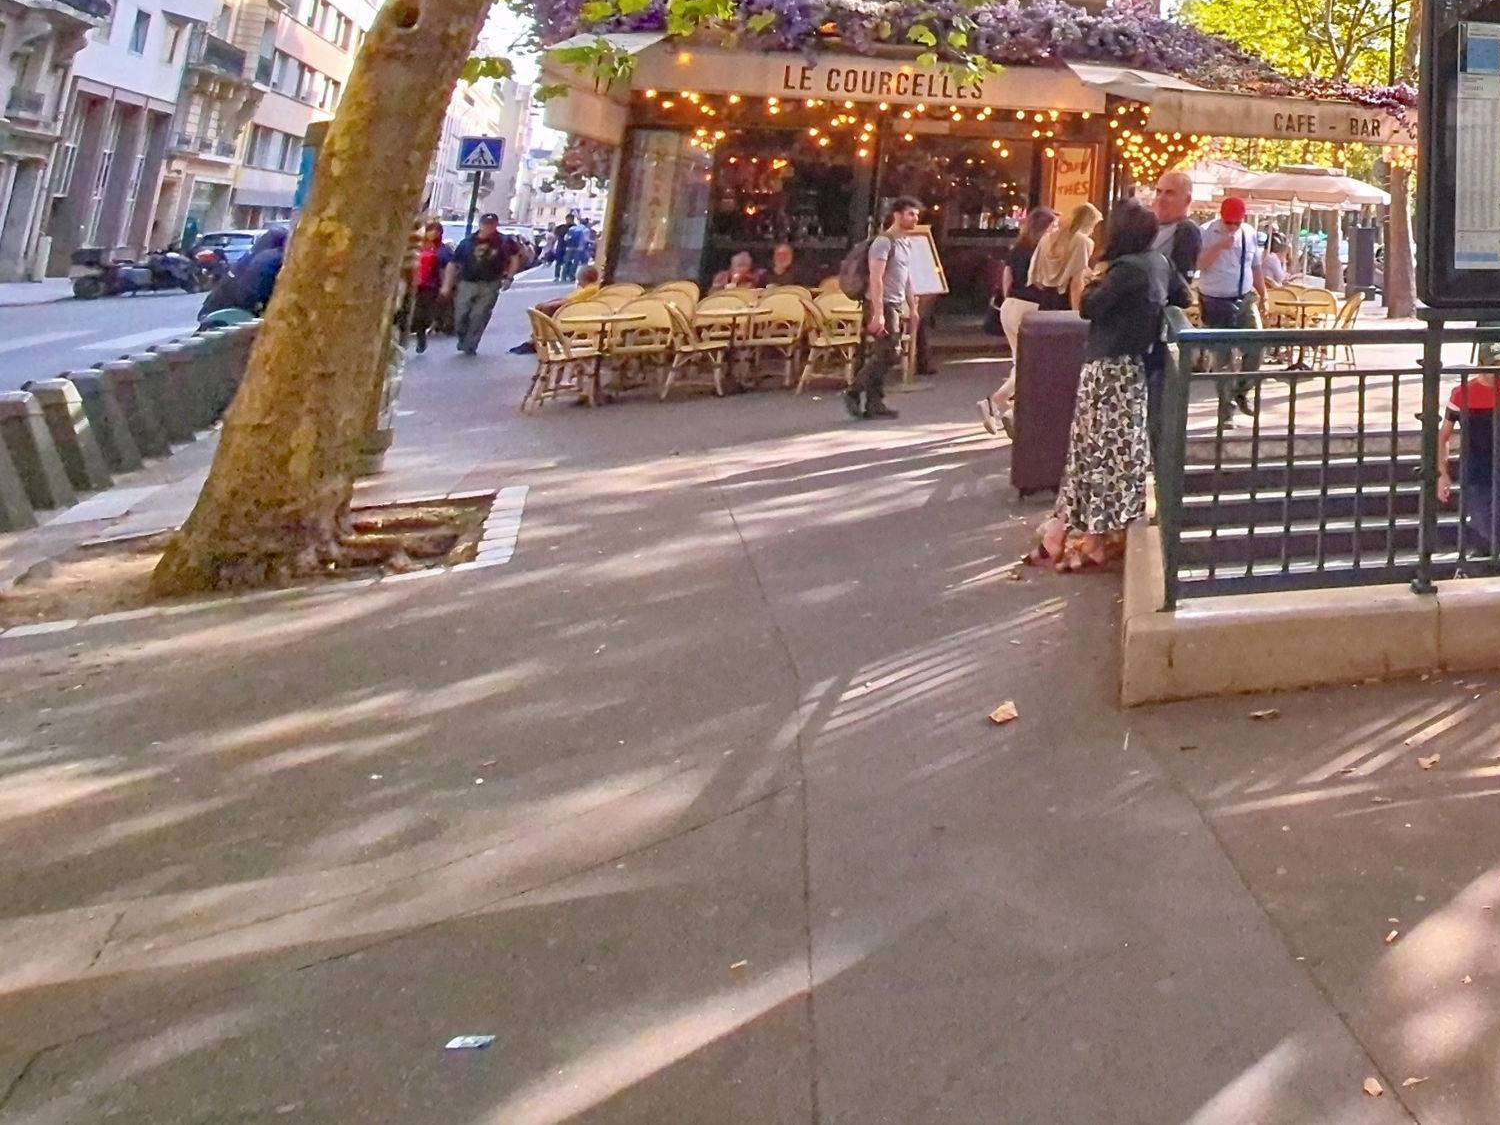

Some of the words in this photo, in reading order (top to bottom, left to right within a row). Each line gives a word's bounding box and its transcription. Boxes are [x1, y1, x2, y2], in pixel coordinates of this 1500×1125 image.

[784, 65, 813, 91] LE
[826, 68, 984, 100] COURCELLES
[1274, 112, 1316, 134] CAFE
[1350, 117, 1381, 137] BAR
